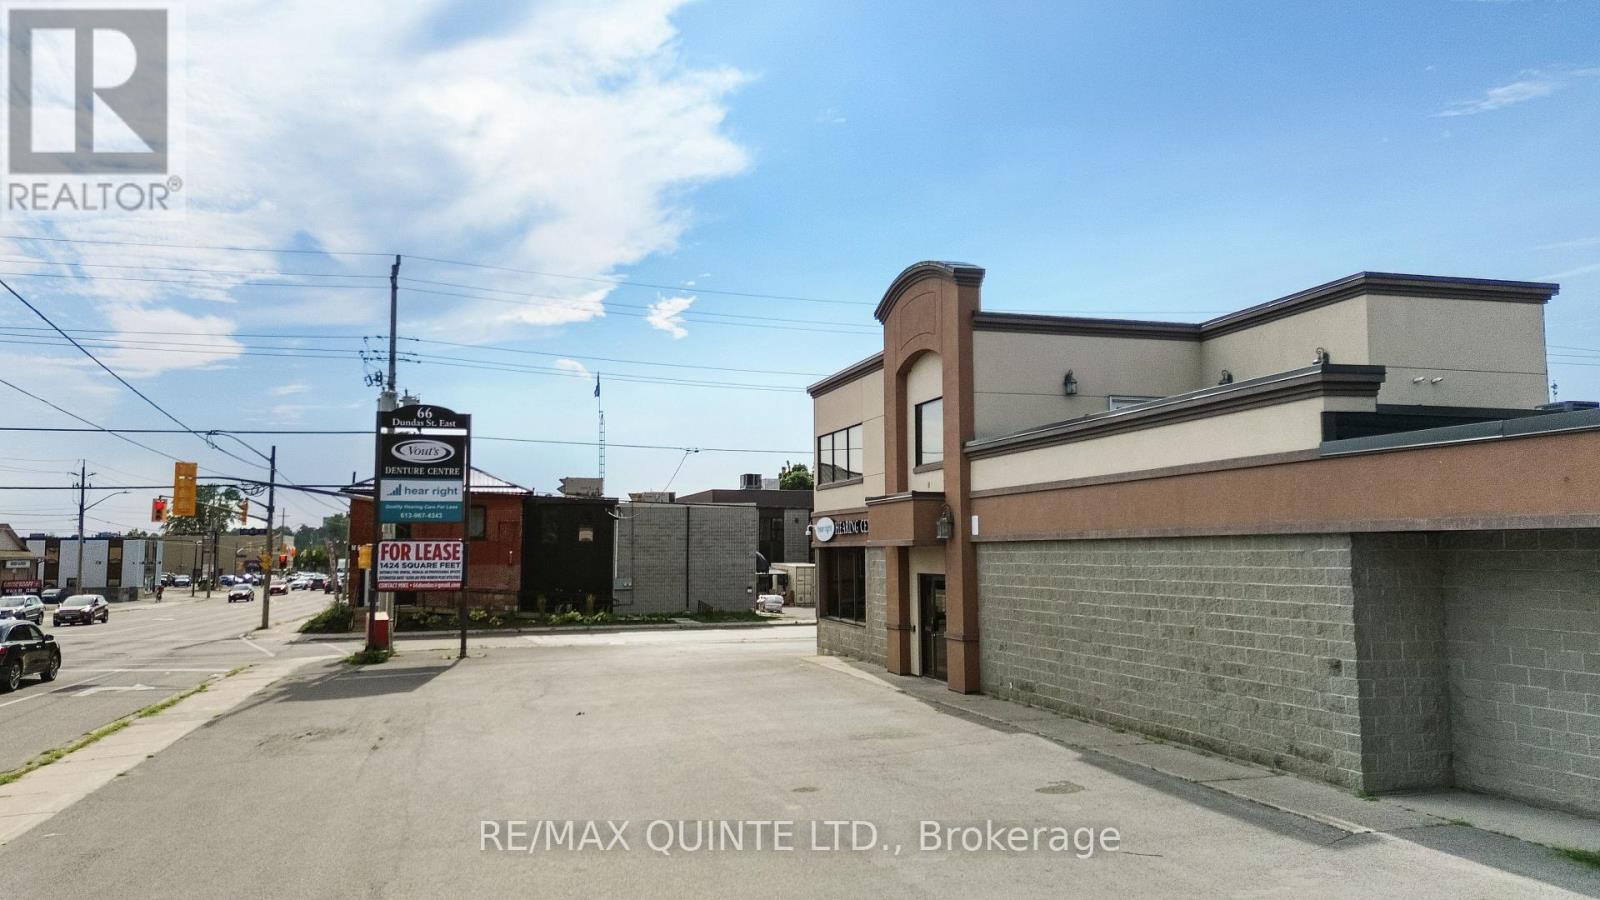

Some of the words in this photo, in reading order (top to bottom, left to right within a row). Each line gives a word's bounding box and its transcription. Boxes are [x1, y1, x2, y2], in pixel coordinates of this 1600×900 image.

[417, 407, 433, 418] 66
[392, 418, 424, 427] Dundas
[425, 419, 437, 427] St.
[385, 466, 425, 475] DENTURE
[427, 467, 460, 475] CENTRE
[404, 486, 430, 495] hear
[432, 487, 458, 497] right
[381, 543, 411, 561] FOR
[415, 543, 461, 561] LEASE
